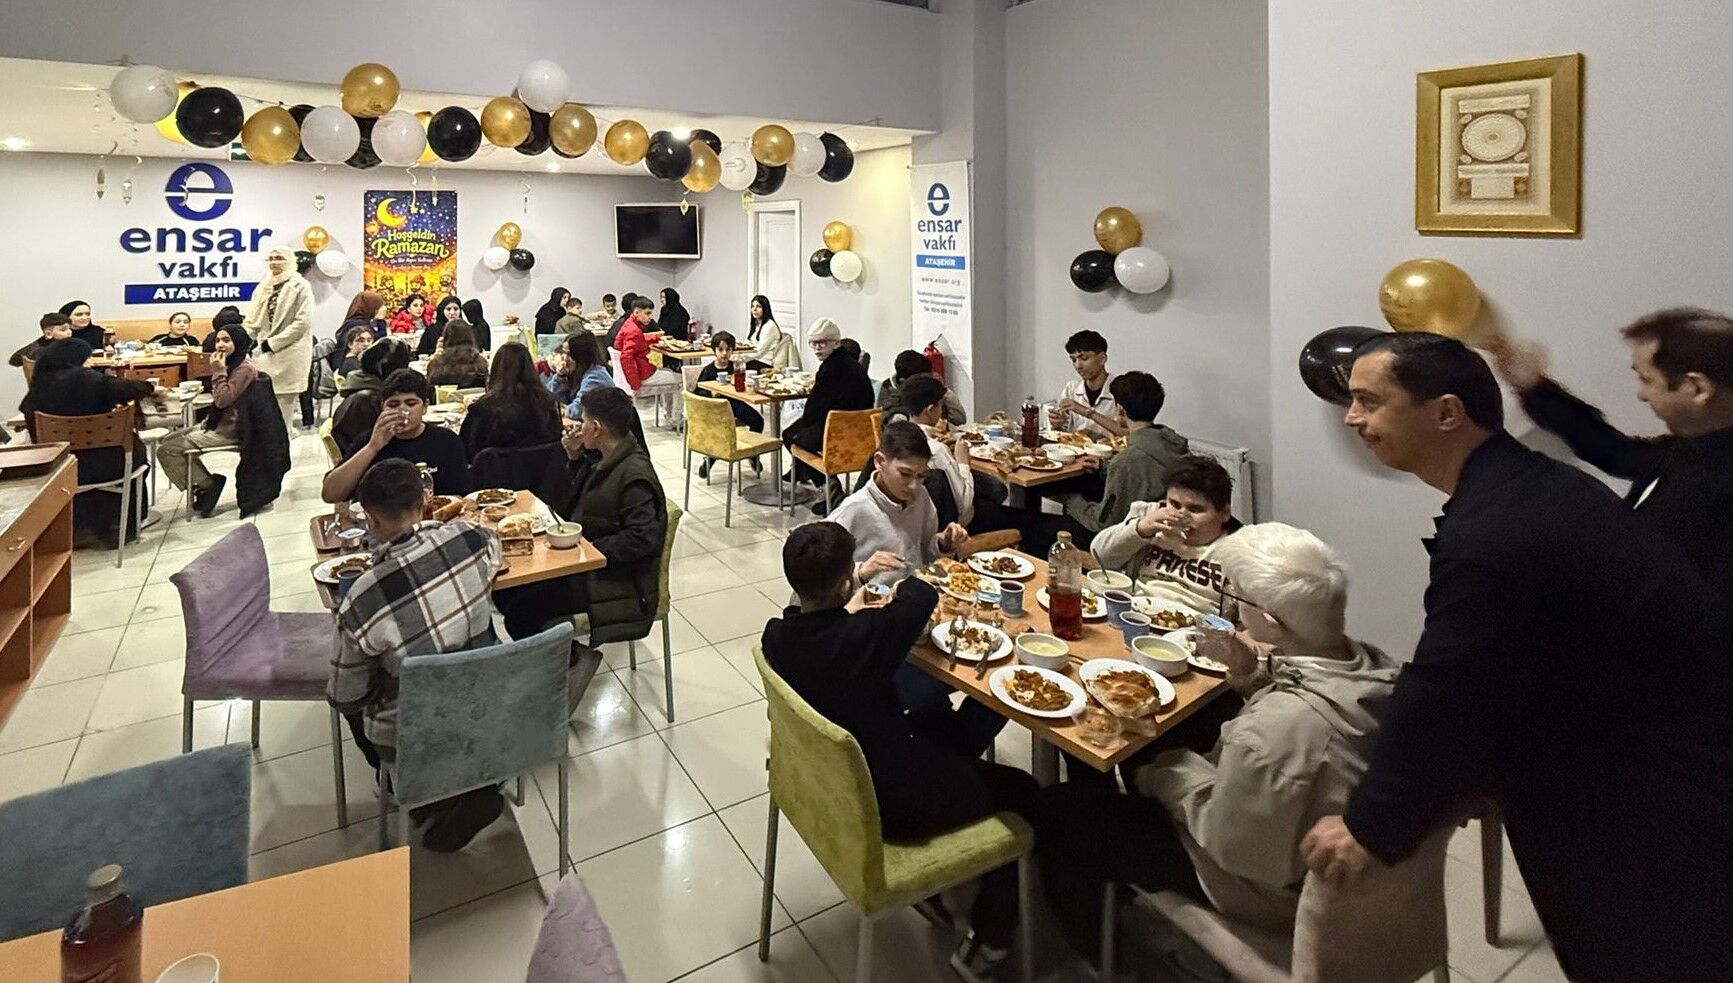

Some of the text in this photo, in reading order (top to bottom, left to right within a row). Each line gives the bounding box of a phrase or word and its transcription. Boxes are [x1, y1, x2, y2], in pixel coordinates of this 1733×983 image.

[917, 219, 962, 233] ensar
[120, 227, 273, 254] ensar
[388, 229, 437, 242] Hoşgeldin
[923, 235, 956, 251] vakfı
[371, 238, 450, 259] Ramazan
[158, 256, 238, 278] vakfı
[153, 285, 240, 301] ATAŞEHİR
